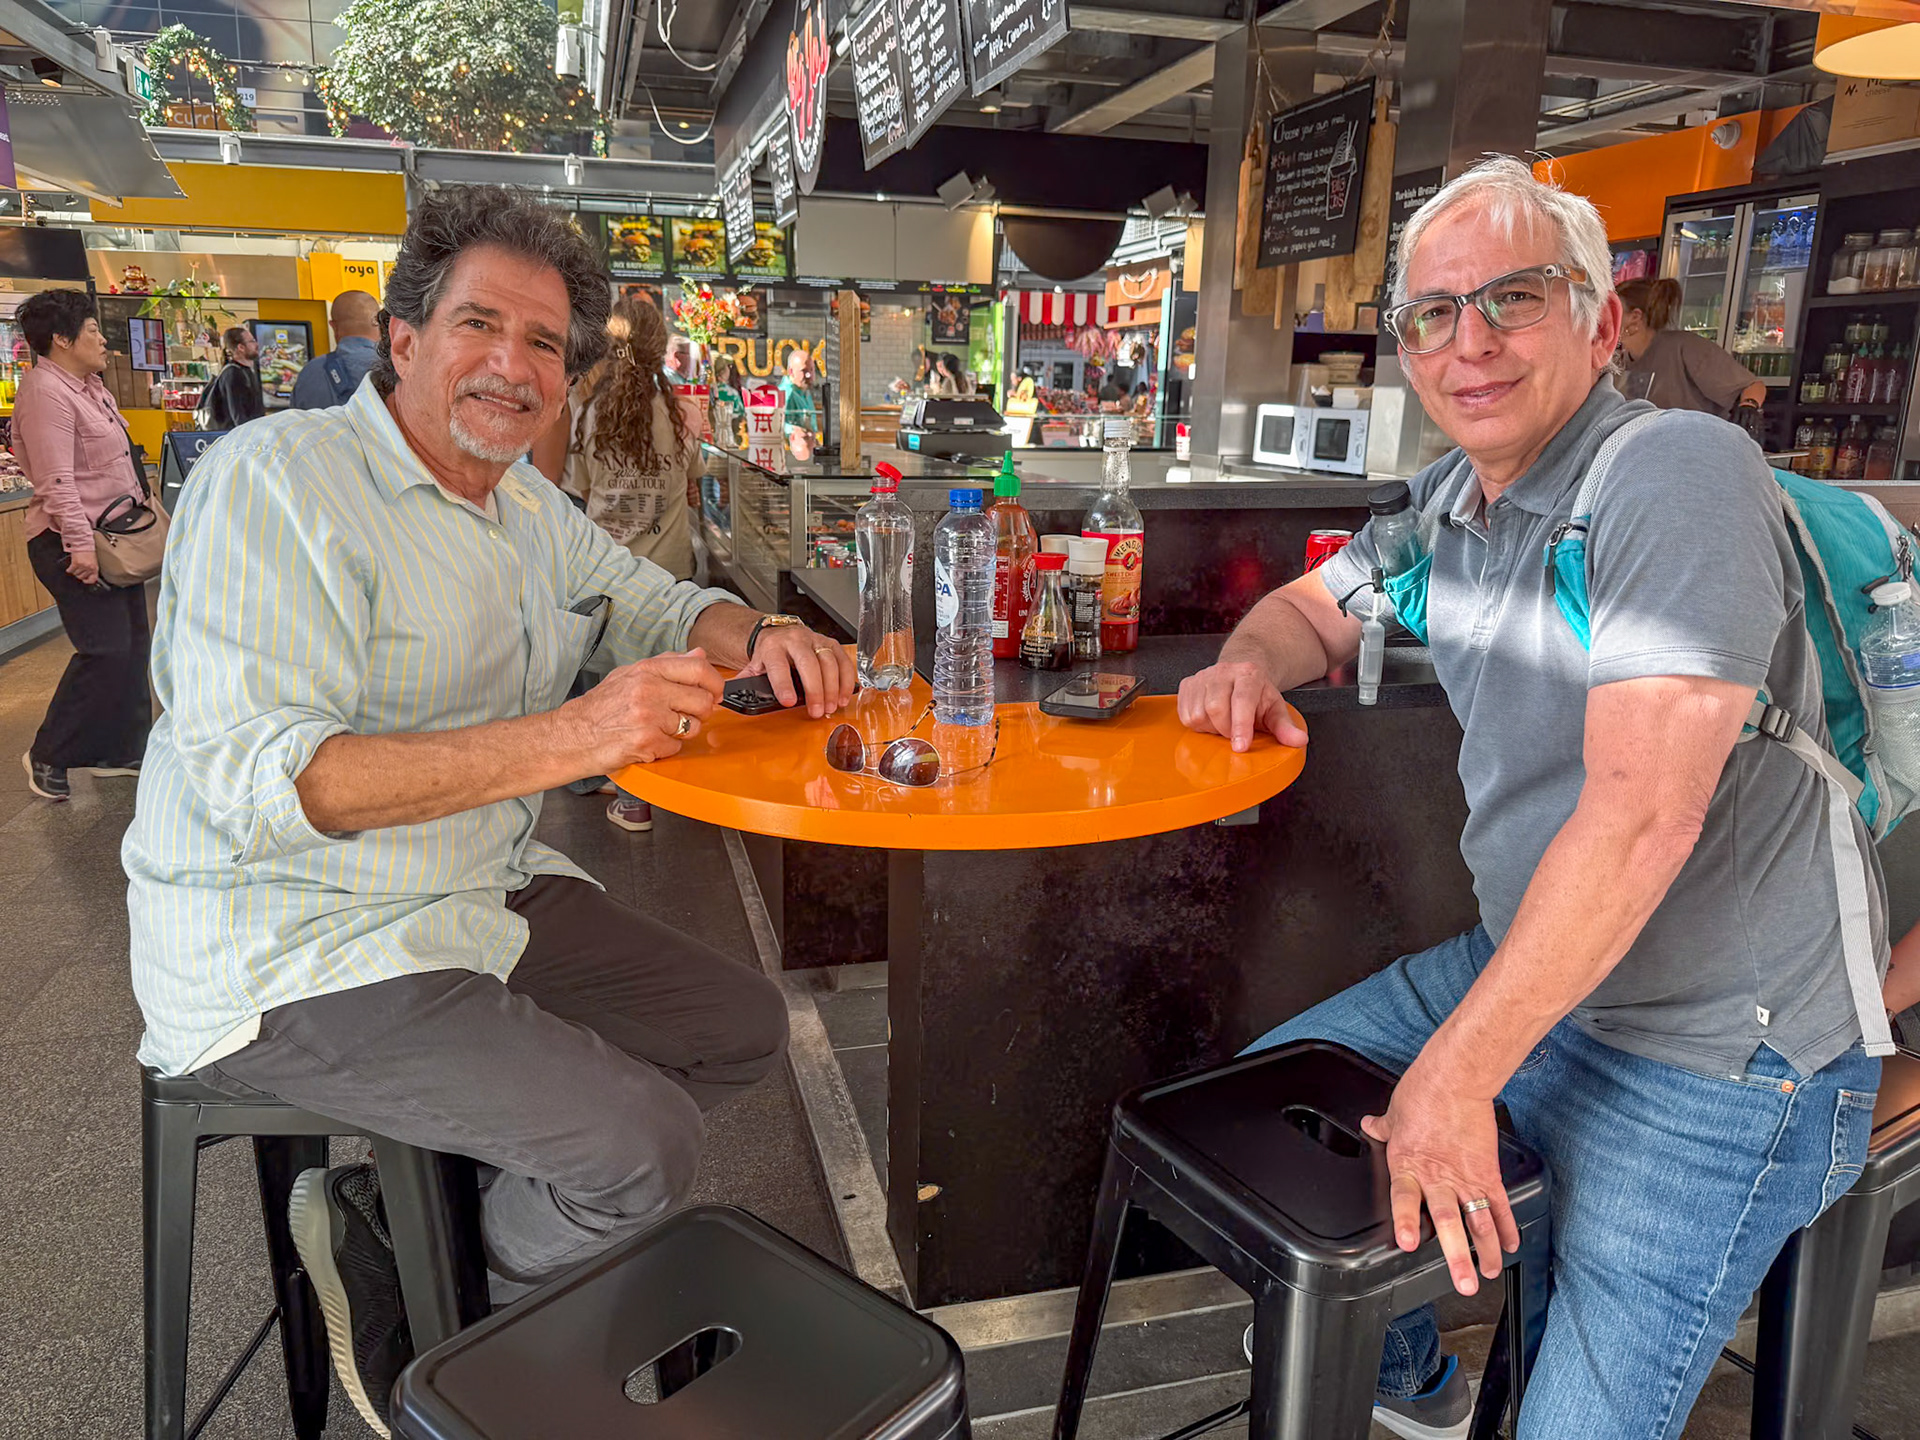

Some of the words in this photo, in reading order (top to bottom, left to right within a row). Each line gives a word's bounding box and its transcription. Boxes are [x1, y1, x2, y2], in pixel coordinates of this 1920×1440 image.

[173, 111, 221, 127] curry
[1395, 188, 1417, 202] Turkish
[1418, 184, 1438, 197] Bread
[641, 478, 666, 490] TOUR
